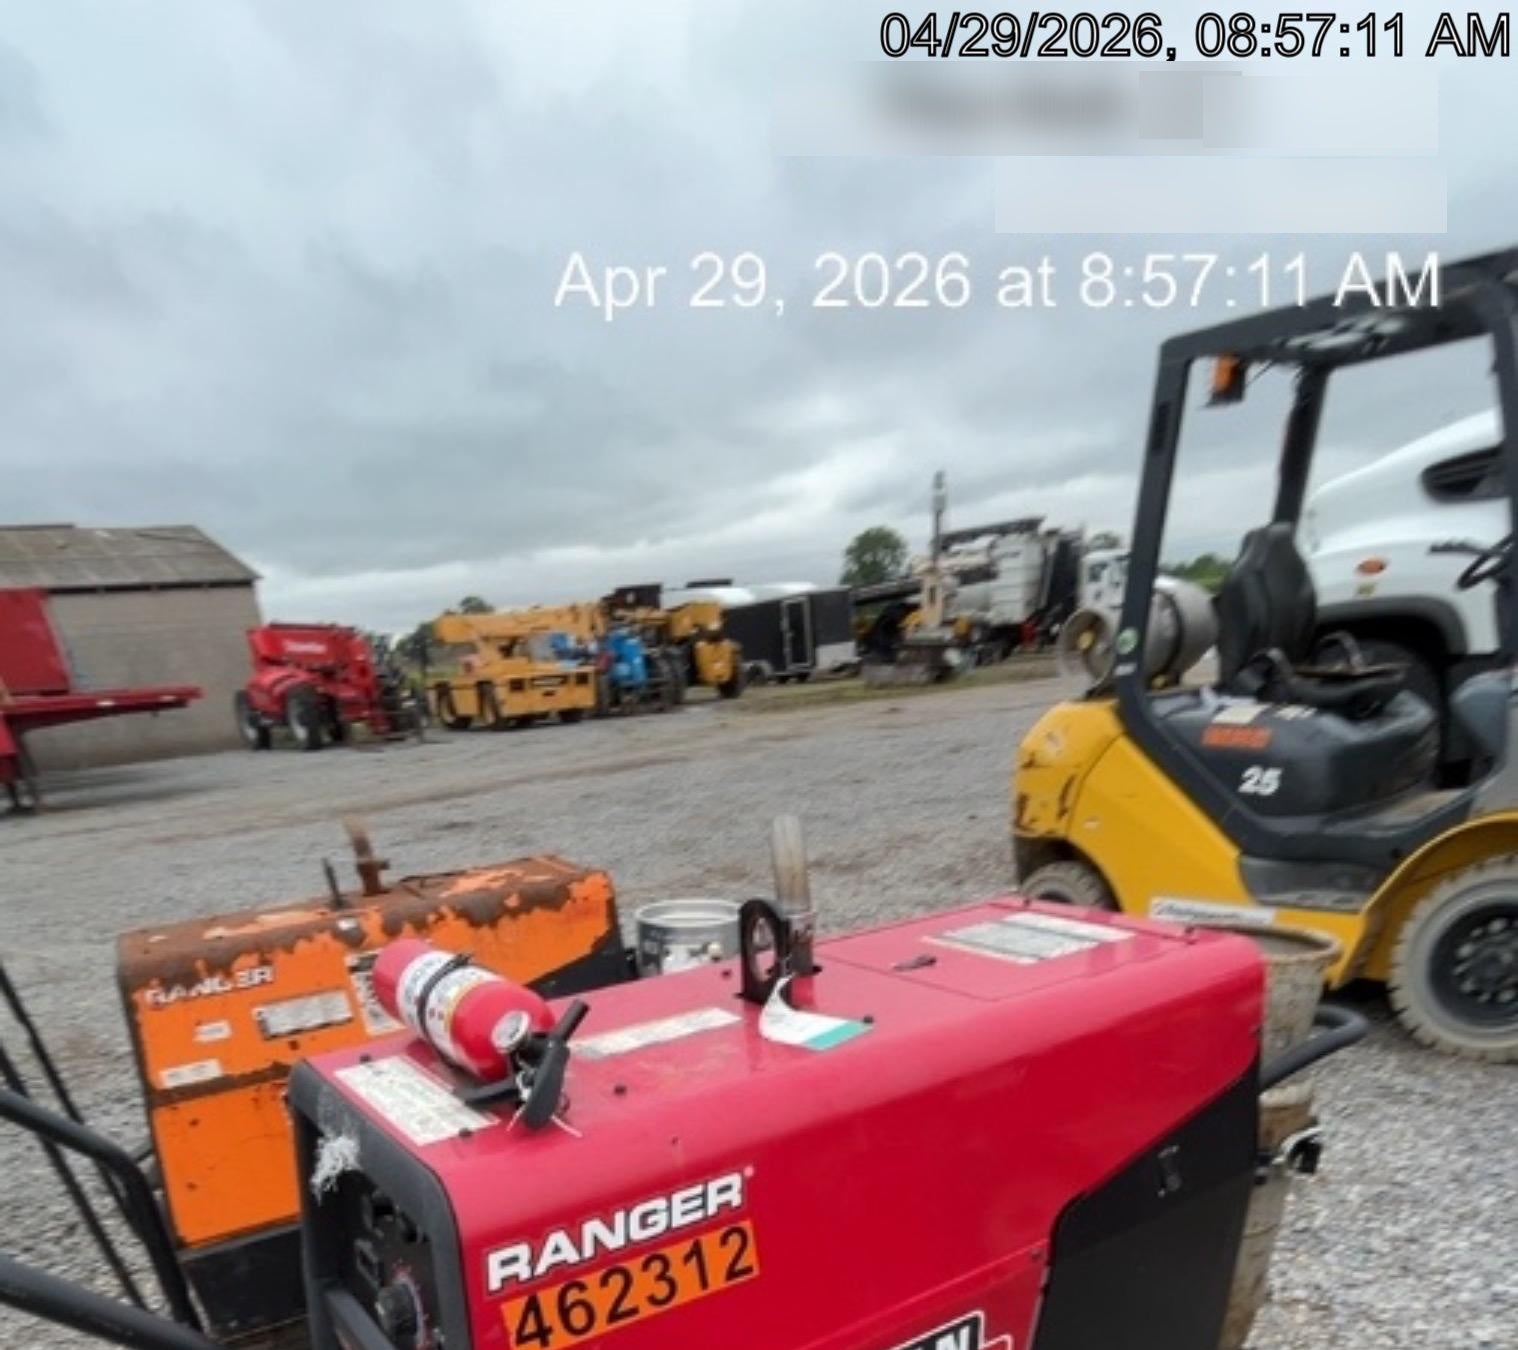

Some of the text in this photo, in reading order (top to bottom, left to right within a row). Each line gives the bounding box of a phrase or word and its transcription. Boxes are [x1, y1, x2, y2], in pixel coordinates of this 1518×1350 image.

[1237, 765, 1283, 796] 25
[487, 1171, 743, 1292] RANGER
[515, 1226, 754, 1349] 462312
